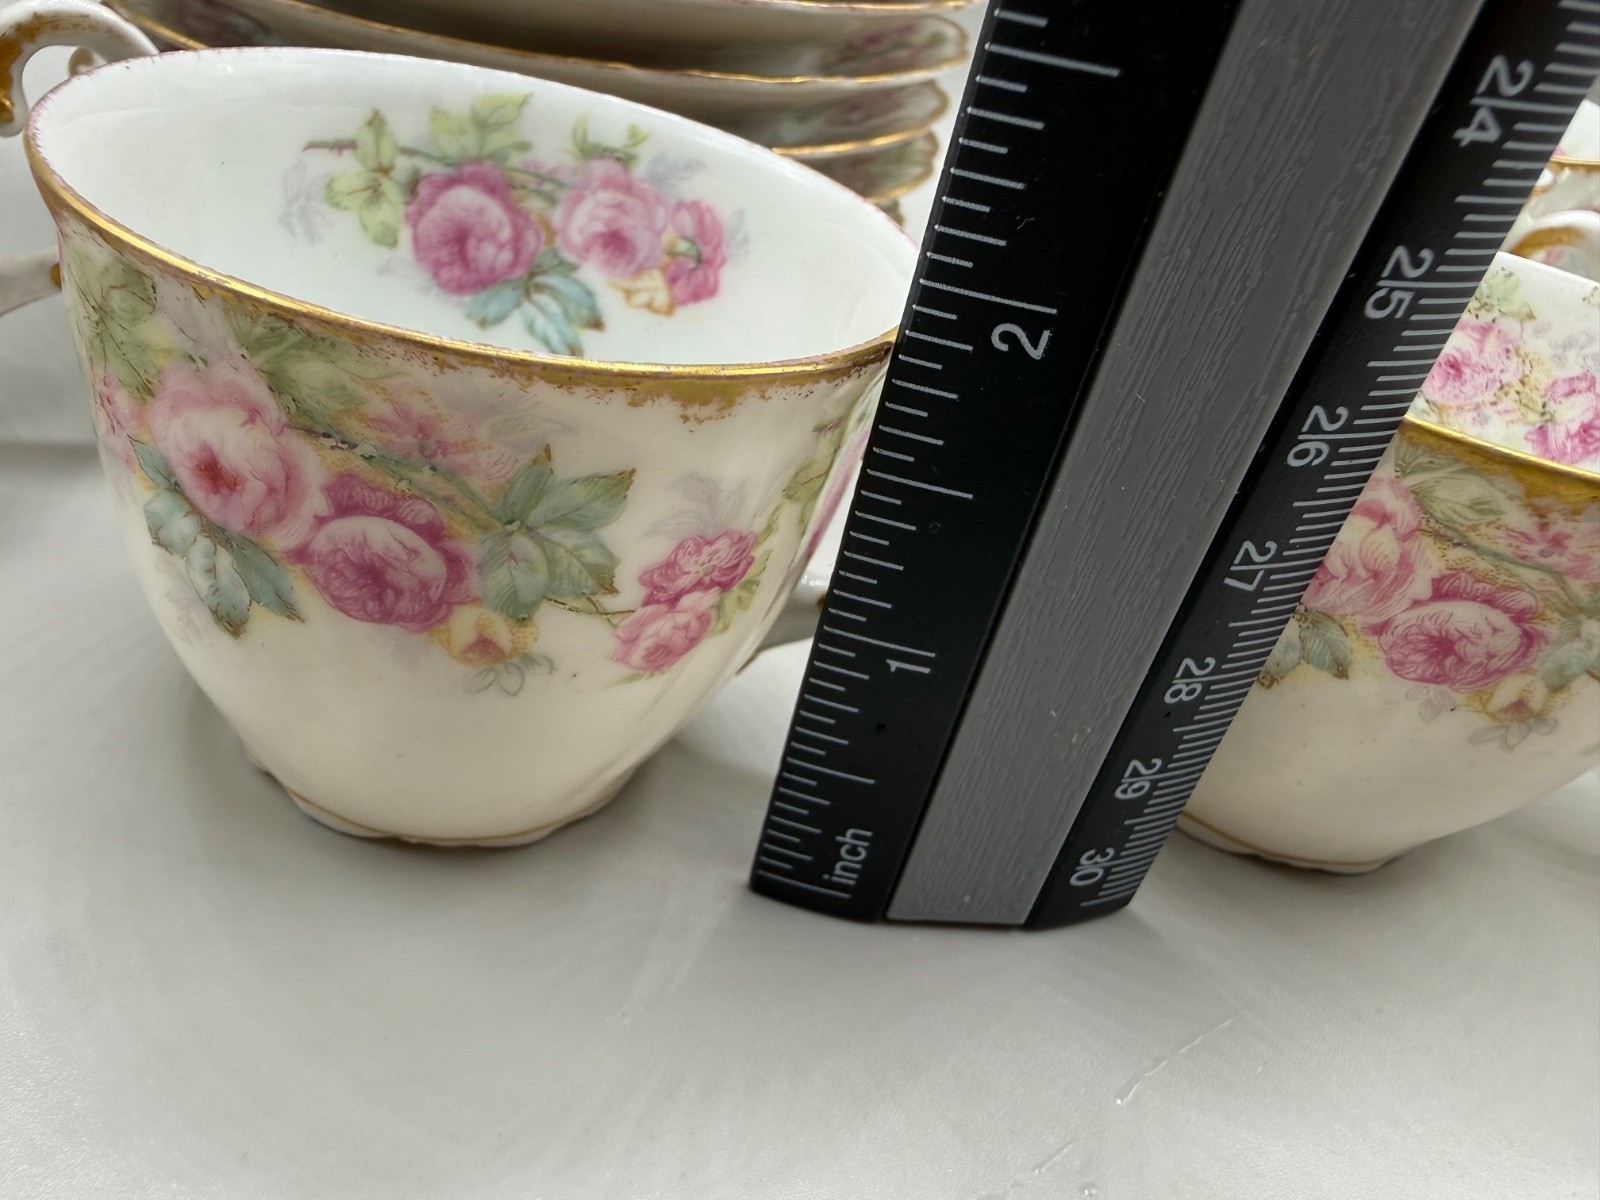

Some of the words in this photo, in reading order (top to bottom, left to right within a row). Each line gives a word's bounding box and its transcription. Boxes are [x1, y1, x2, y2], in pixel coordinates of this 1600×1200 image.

[1453, 55, 1534, 147] 24
[1364, 245, 1435, 321] 25
[991, 322, 1050, 360] 2
[1286, 404, 1349, 468] 26
[1222, 540, 1276, 592] 27
[885, 659, 931, 674] 1
[1163, 656, 1216, 704] 28
[1114, 757, 1163, 801] 29
[823, 827, 873, 885] inch
[1068, 846, 1116, 887] 30
